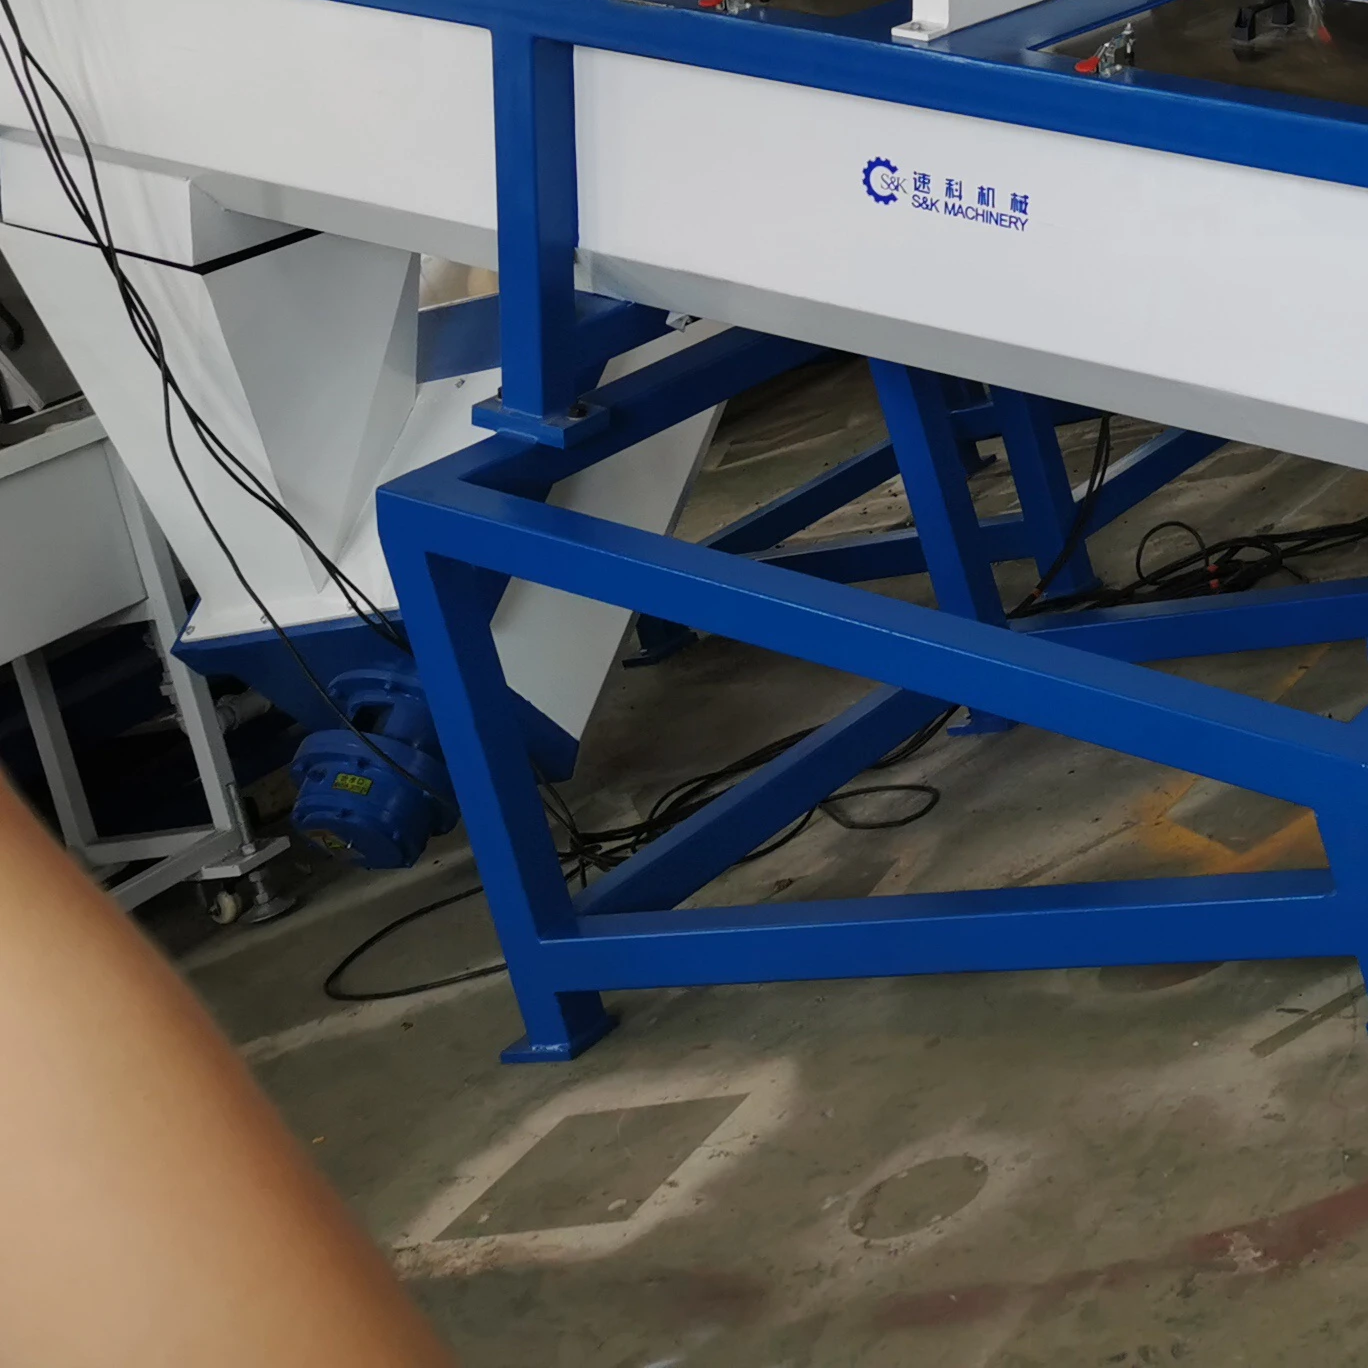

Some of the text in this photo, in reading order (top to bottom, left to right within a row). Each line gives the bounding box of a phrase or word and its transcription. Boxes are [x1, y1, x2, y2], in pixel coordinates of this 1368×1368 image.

[880, 173, 908, 194] S&K
[912, 171, 1030, 215] 速科机械
[911, 194, 1029, 232] S&K MACHINERY
